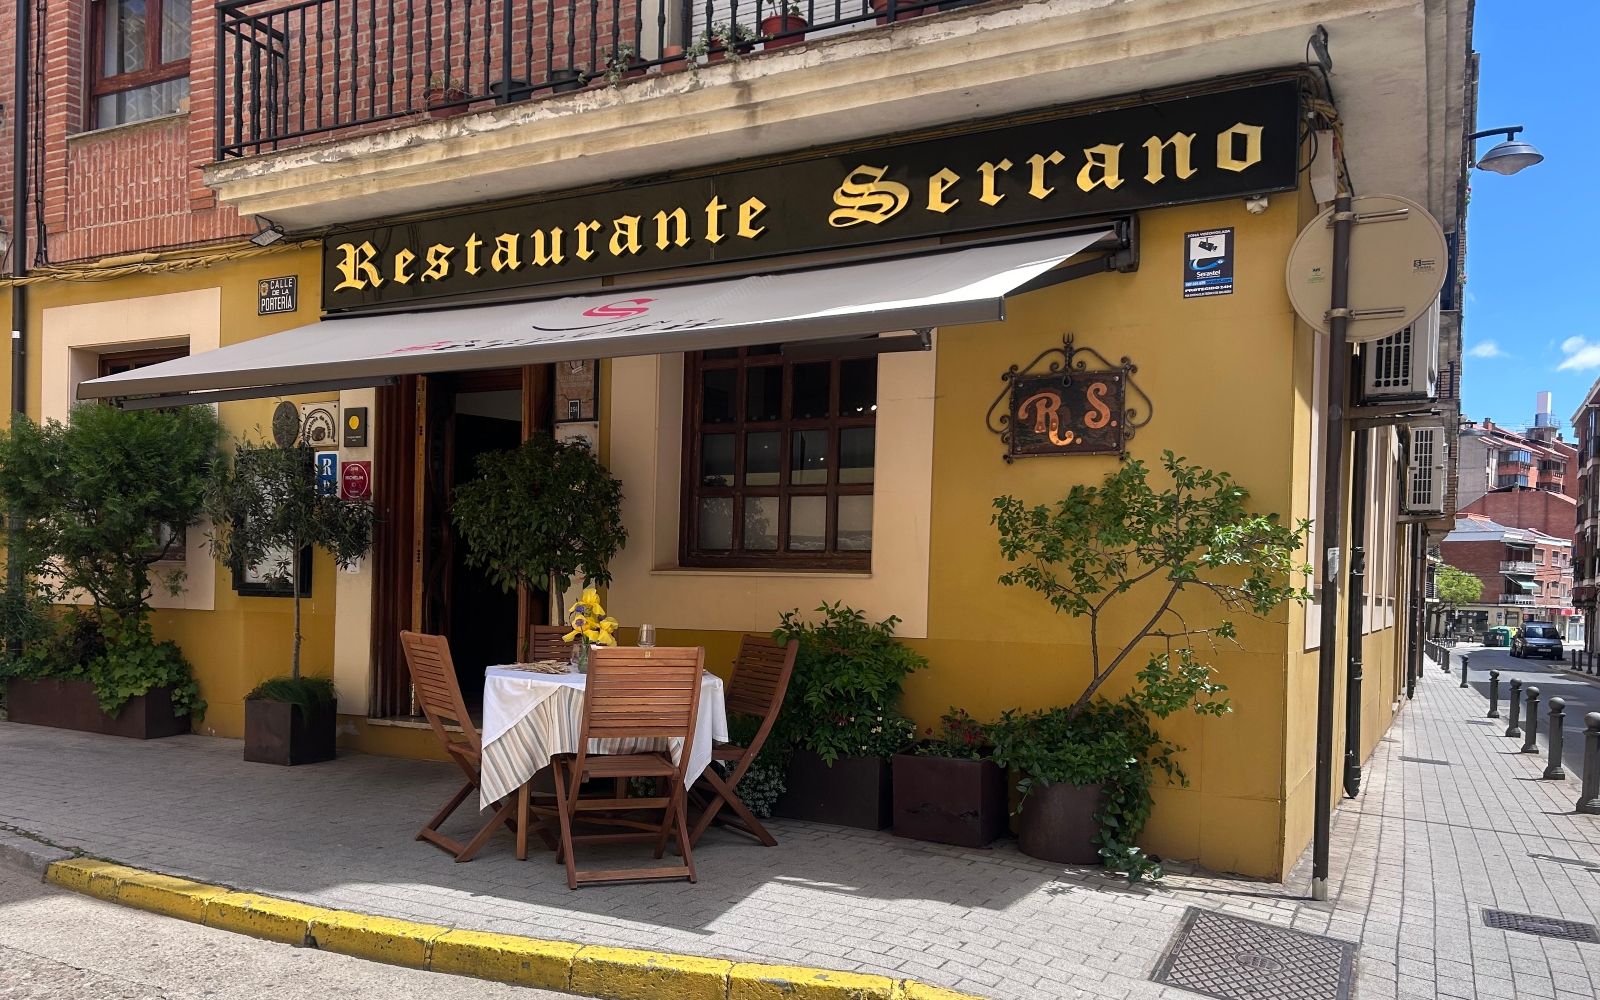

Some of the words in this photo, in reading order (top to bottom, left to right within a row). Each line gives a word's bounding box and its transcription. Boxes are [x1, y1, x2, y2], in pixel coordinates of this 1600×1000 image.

[333, 195, 767, 292] Restaurante
[828, 121, 1264, 229] Serrano
[271, 279, 292, 289] CALLE
[262, 294, 292, 311] PORTERÍA
[322, 458, 332, 476] R
